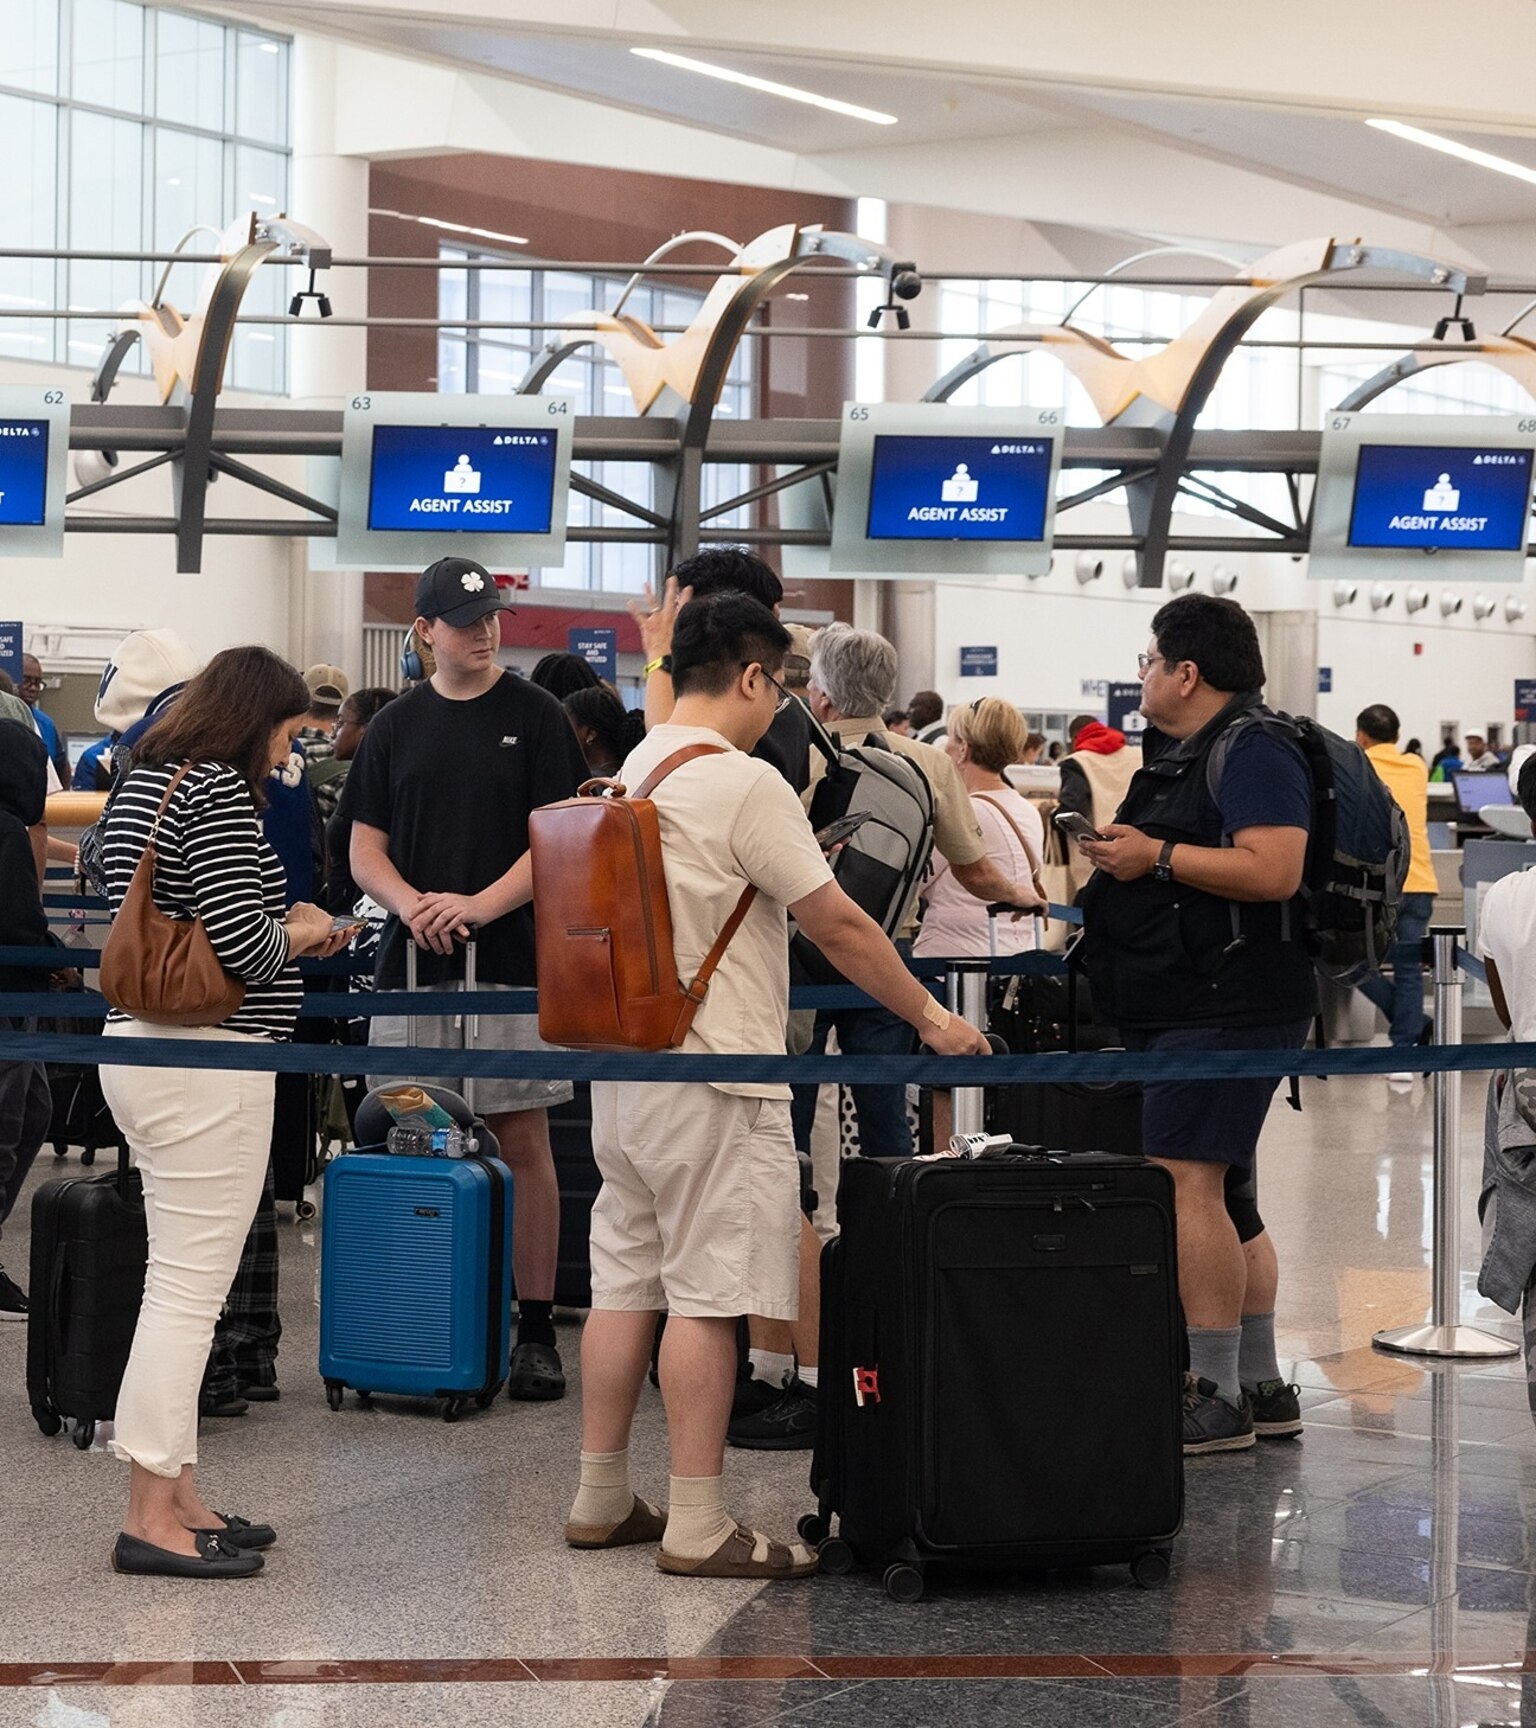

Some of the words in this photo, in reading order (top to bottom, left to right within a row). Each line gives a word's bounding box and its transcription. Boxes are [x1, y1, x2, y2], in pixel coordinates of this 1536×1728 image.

[44, 391, 64, 405] 62
[352, 396, 371, 410] 63
[548, 401, 568, 415] 64
[850, 407, 869, 421] 65
[1038, 411, 1058, 424] 66
[1332, 417, 1351, 430] 67
[1518, 419, 1536, 433] 68
[504, 436, 539, 445] DELTA
[1001, 445, 1035, 454] DELTA
[1483, 455, 1517, 464] DELTA
[409, 498, 461, 513] AGENT
[462, 499, 513, 514] ASSIST
[907, 507, 959, 521] AGENT
[959, 507, 1009, 522] ASSIST
[1388, 515, 1439, 530] AGENT
[1439, 516, 1488, 531] ASSIST
